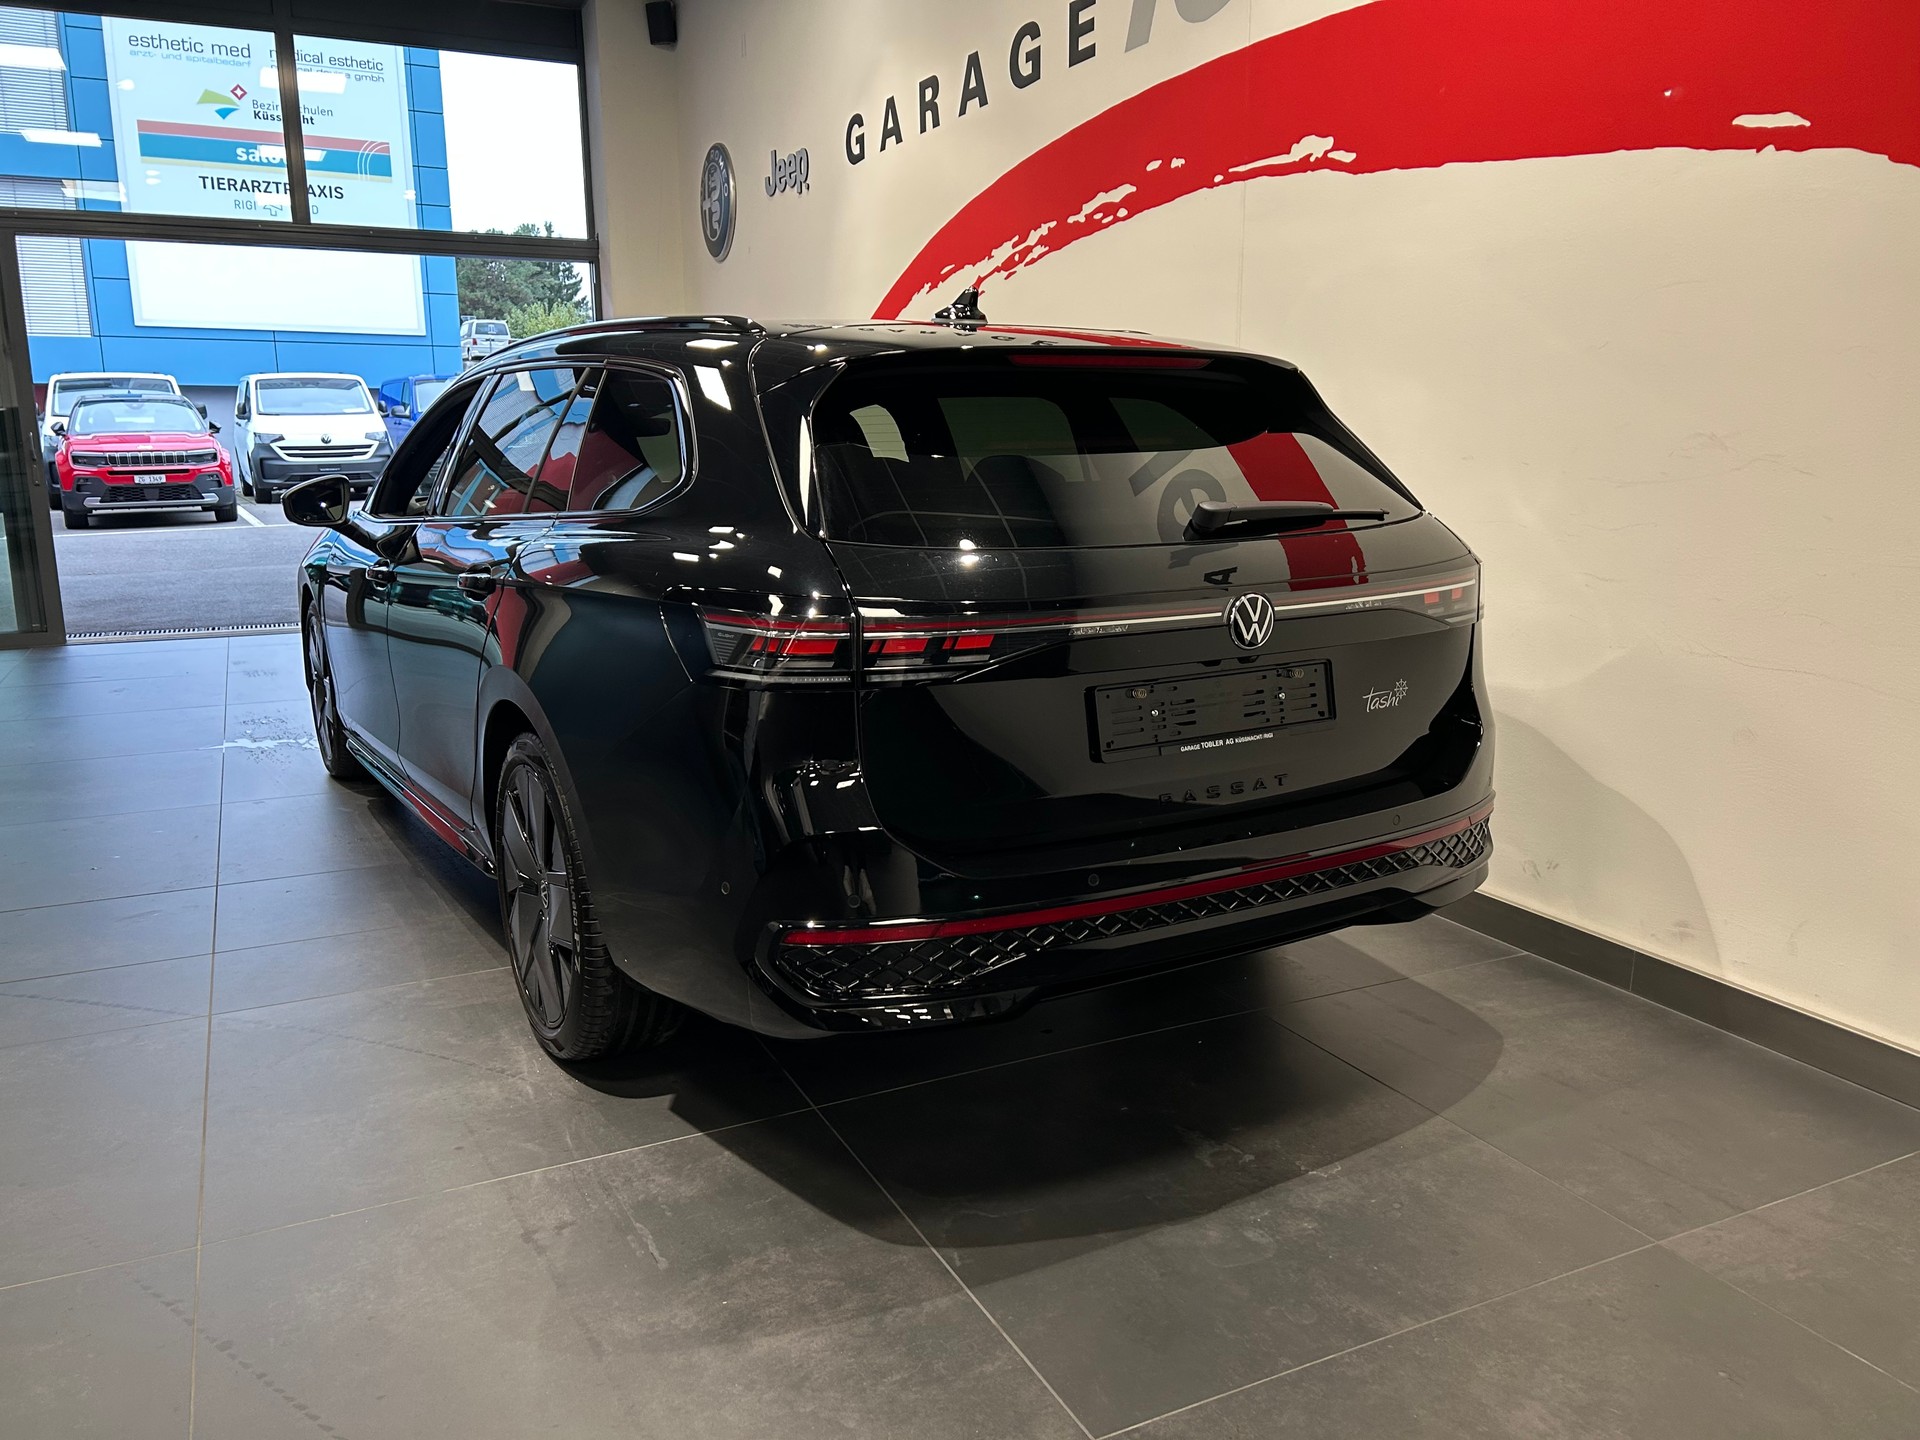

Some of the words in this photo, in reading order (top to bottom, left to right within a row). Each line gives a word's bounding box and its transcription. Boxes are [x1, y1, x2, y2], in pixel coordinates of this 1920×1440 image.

[128, 34, 204, 53] esthetic
[211, 43, 251, 59] med
[161, 52, 182, 60] und
[186, 55, 251, 67] spitalbedarf
[329, 56, 384, 71] esthetic
[354, 73, 385, 83] gmbh
[845, 0, 1097, 165] GARAGE
[253, 110, 315, 125] Küssht
[765, 148, 809, 197] Jeep
[198, 175, 344, 200] TIERARZTPAXIS
[234, 199, 257, 211] RIGI
[1180, 743, 1201, 752] GARAGE
[1201, 739, 1224, 749] TOBLER
[1158, 773, 1289, 805] PASSAT
